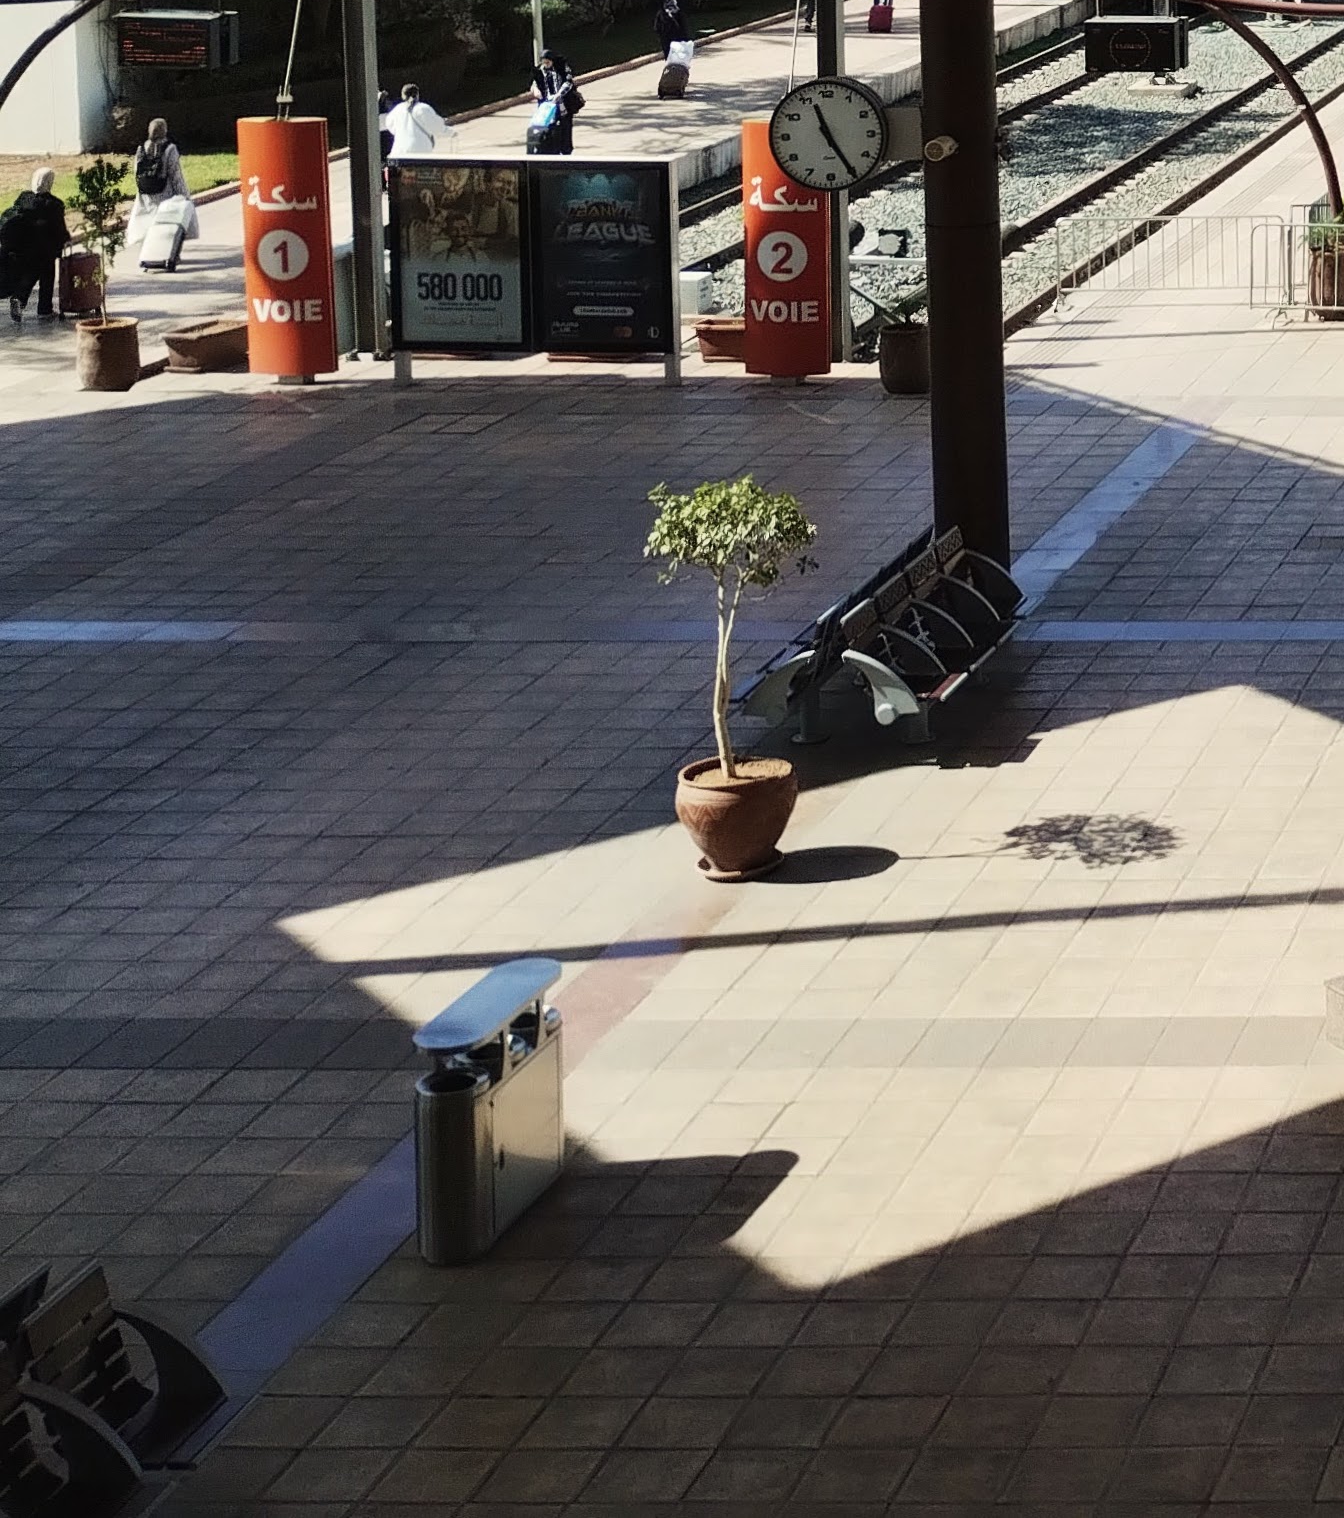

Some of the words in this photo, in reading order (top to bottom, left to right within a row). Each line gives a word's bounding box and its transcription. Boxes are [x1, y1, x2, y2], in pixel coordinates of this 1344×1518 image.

[818, 90, 834, 99] 12
[845, 93, 852, 103] 1
[785, 113, 801, 122] 10
[859, 110, 869, 119] 2
[781, 133, 791, 141] 9
[866, 129, 876, 138] 3
[789, 153, 798, 162] 8
[861, 150, 870, 158] 4
[805, 168, 814, 177] 7
[826, 173, 836, 181] 6
[248, 176, 317, 211] سكة
[749, 176, 818, 212] سكة
[553, 222, 656, 244] LEAGUE
[273, 239, 289, 273] 1
[770, 242, 793, 274] 2
[417, 272, 457, 301] 580
[462, 272, 503, 302] 000
[253, 298, 323, 323] VOIE
[751, 299, 819, 323] VOIE
